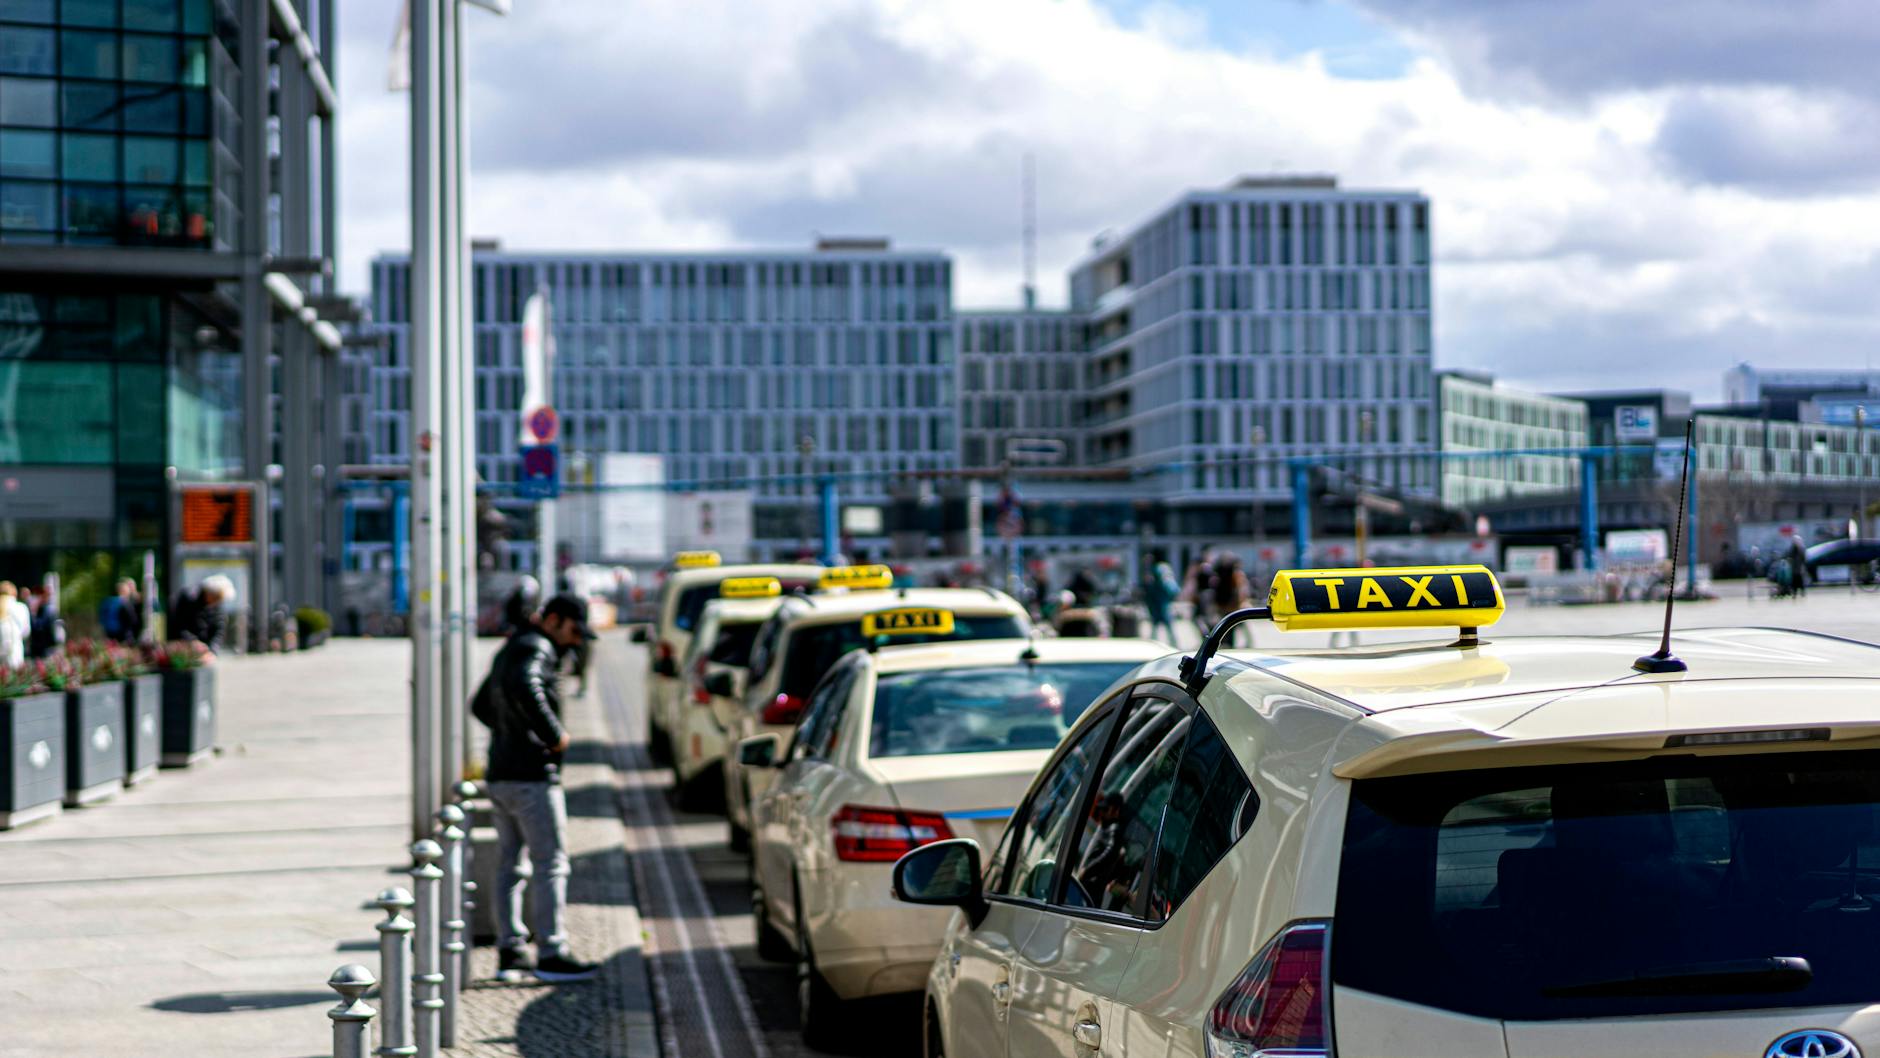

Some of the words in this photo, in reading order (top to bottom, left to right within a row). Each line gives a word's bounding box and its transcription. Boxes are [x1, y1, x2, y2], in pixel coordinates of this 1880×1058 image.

[211, 491, 236, 536] 7
[1314, 576, 1469, 609] TAXI
[880, 613, 935, 628] TAXI
